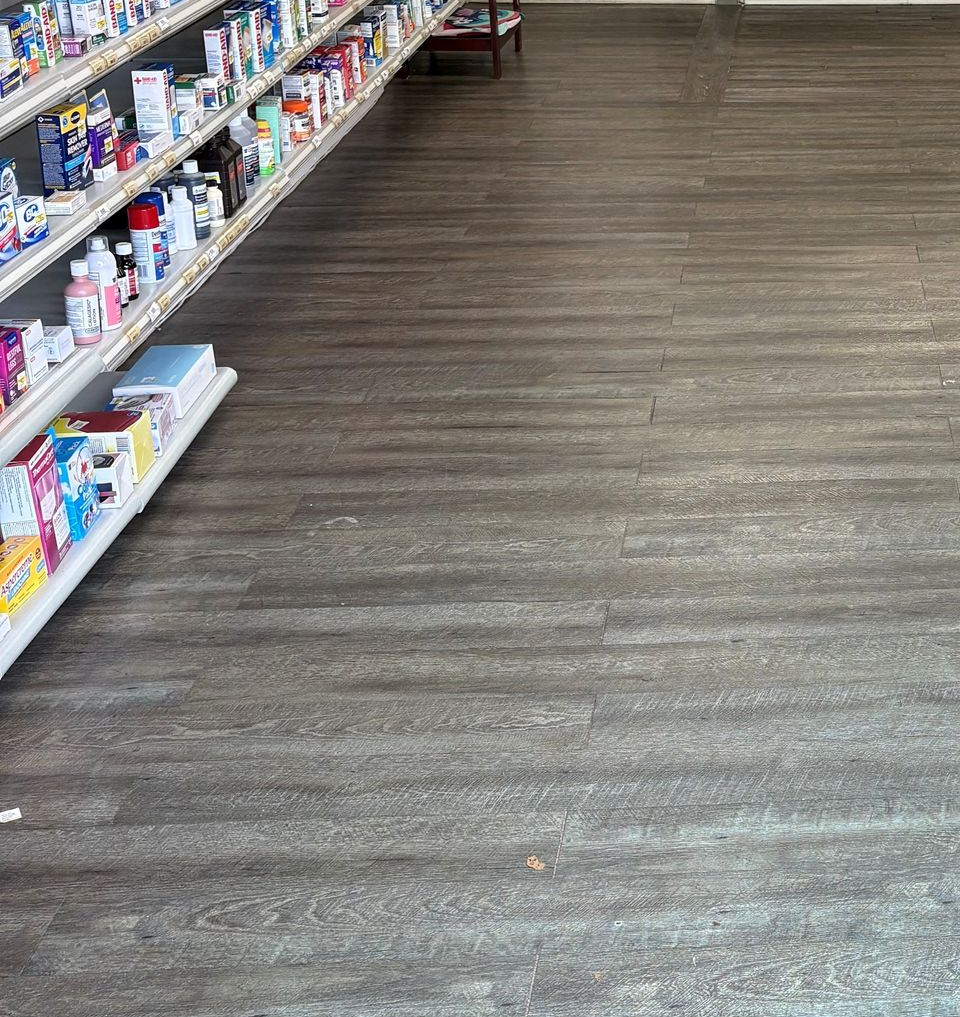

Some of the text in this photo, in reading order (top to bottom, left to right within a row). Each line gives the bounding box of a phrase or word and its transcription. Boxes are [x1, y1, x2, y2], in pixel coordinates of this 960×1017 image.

[41, 6, 54, 60] BAND-AID
[254, 12, 264, 68] BAND-AID
[67, 134, 78, 146] SKIN
[68, 138, 88, 156] REMOVER
[1, 552, 34, 598] Aspercreme
